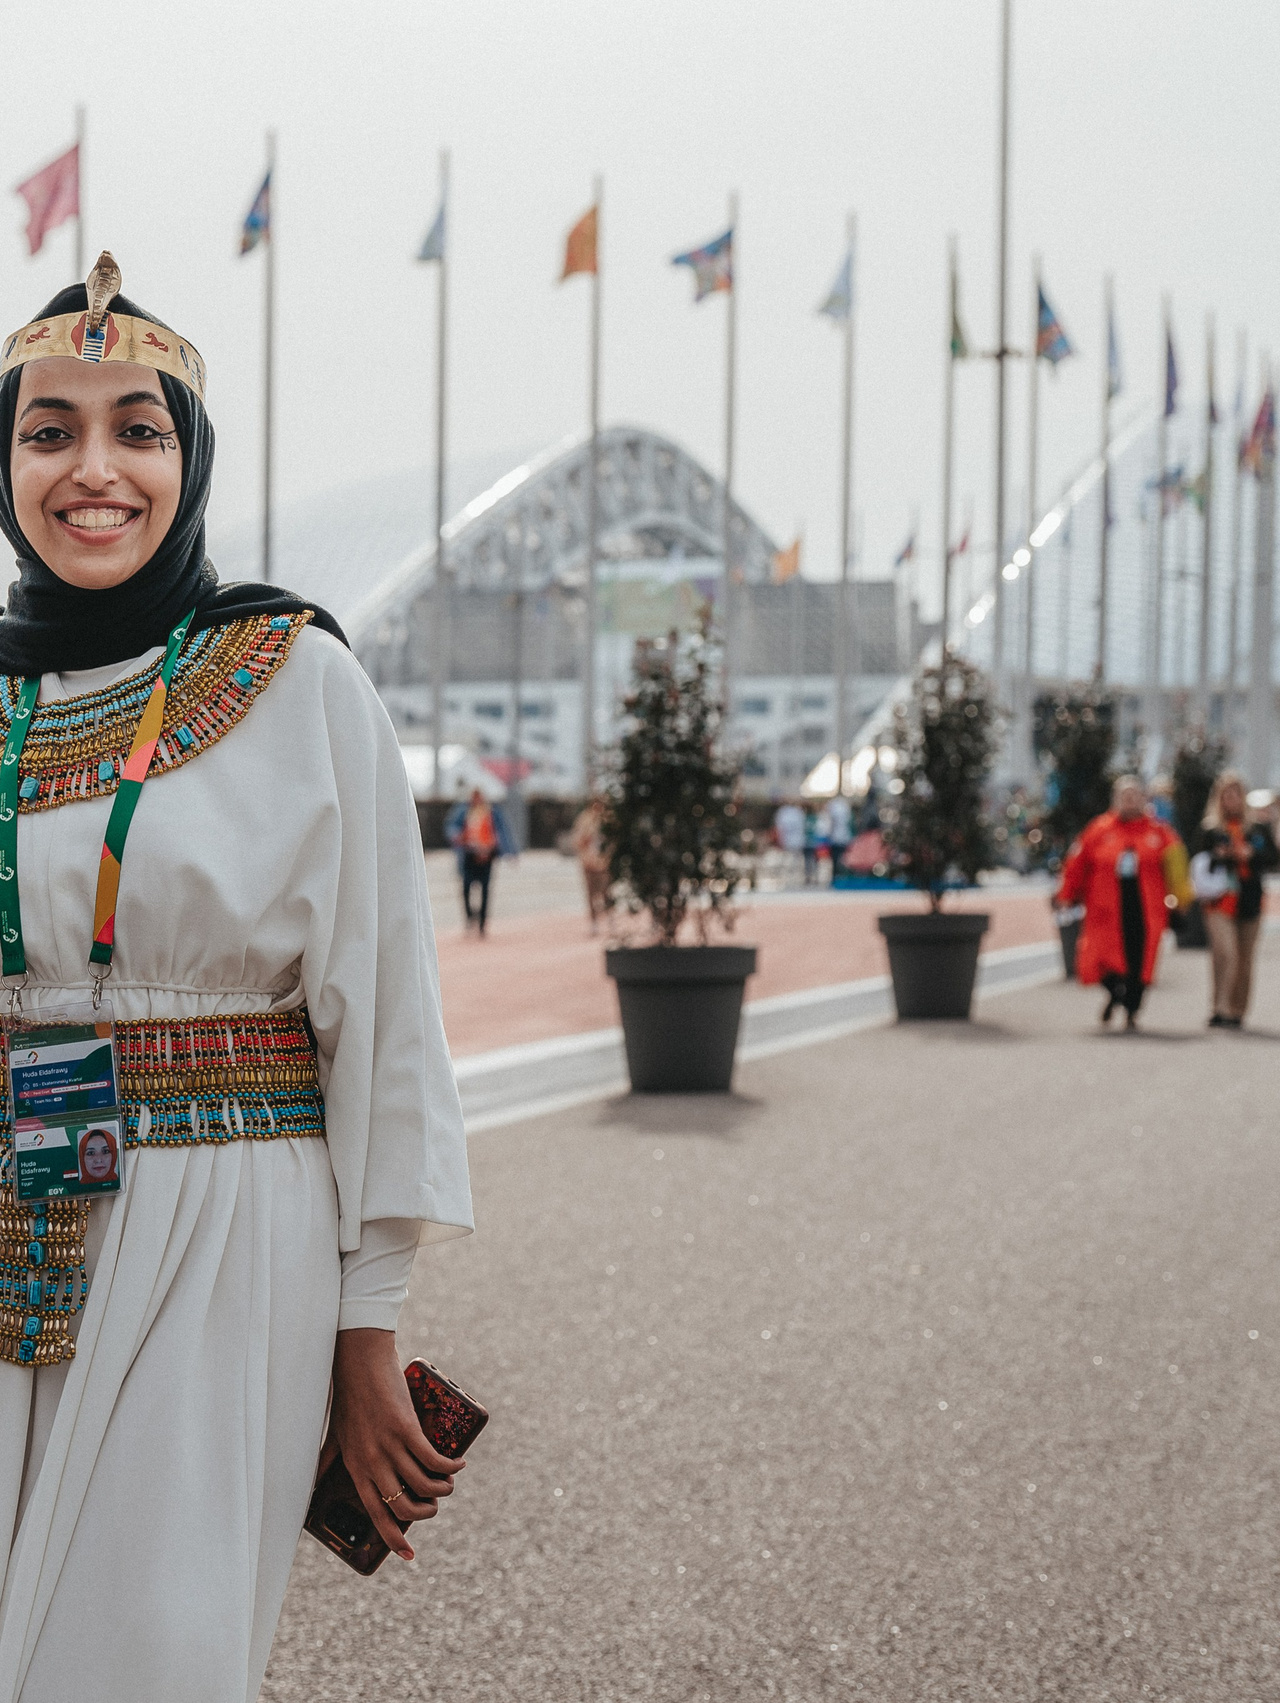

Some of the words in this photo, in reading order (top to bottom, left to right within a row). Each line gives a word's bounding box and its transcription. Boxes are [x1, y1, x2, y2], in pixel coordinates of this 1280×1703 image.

[38, 1067, 68, 1076] Eldafrawy
[21, 1167, 50, 1175] Eldafrawy
[48, 1187, 64, 1196] EGY
